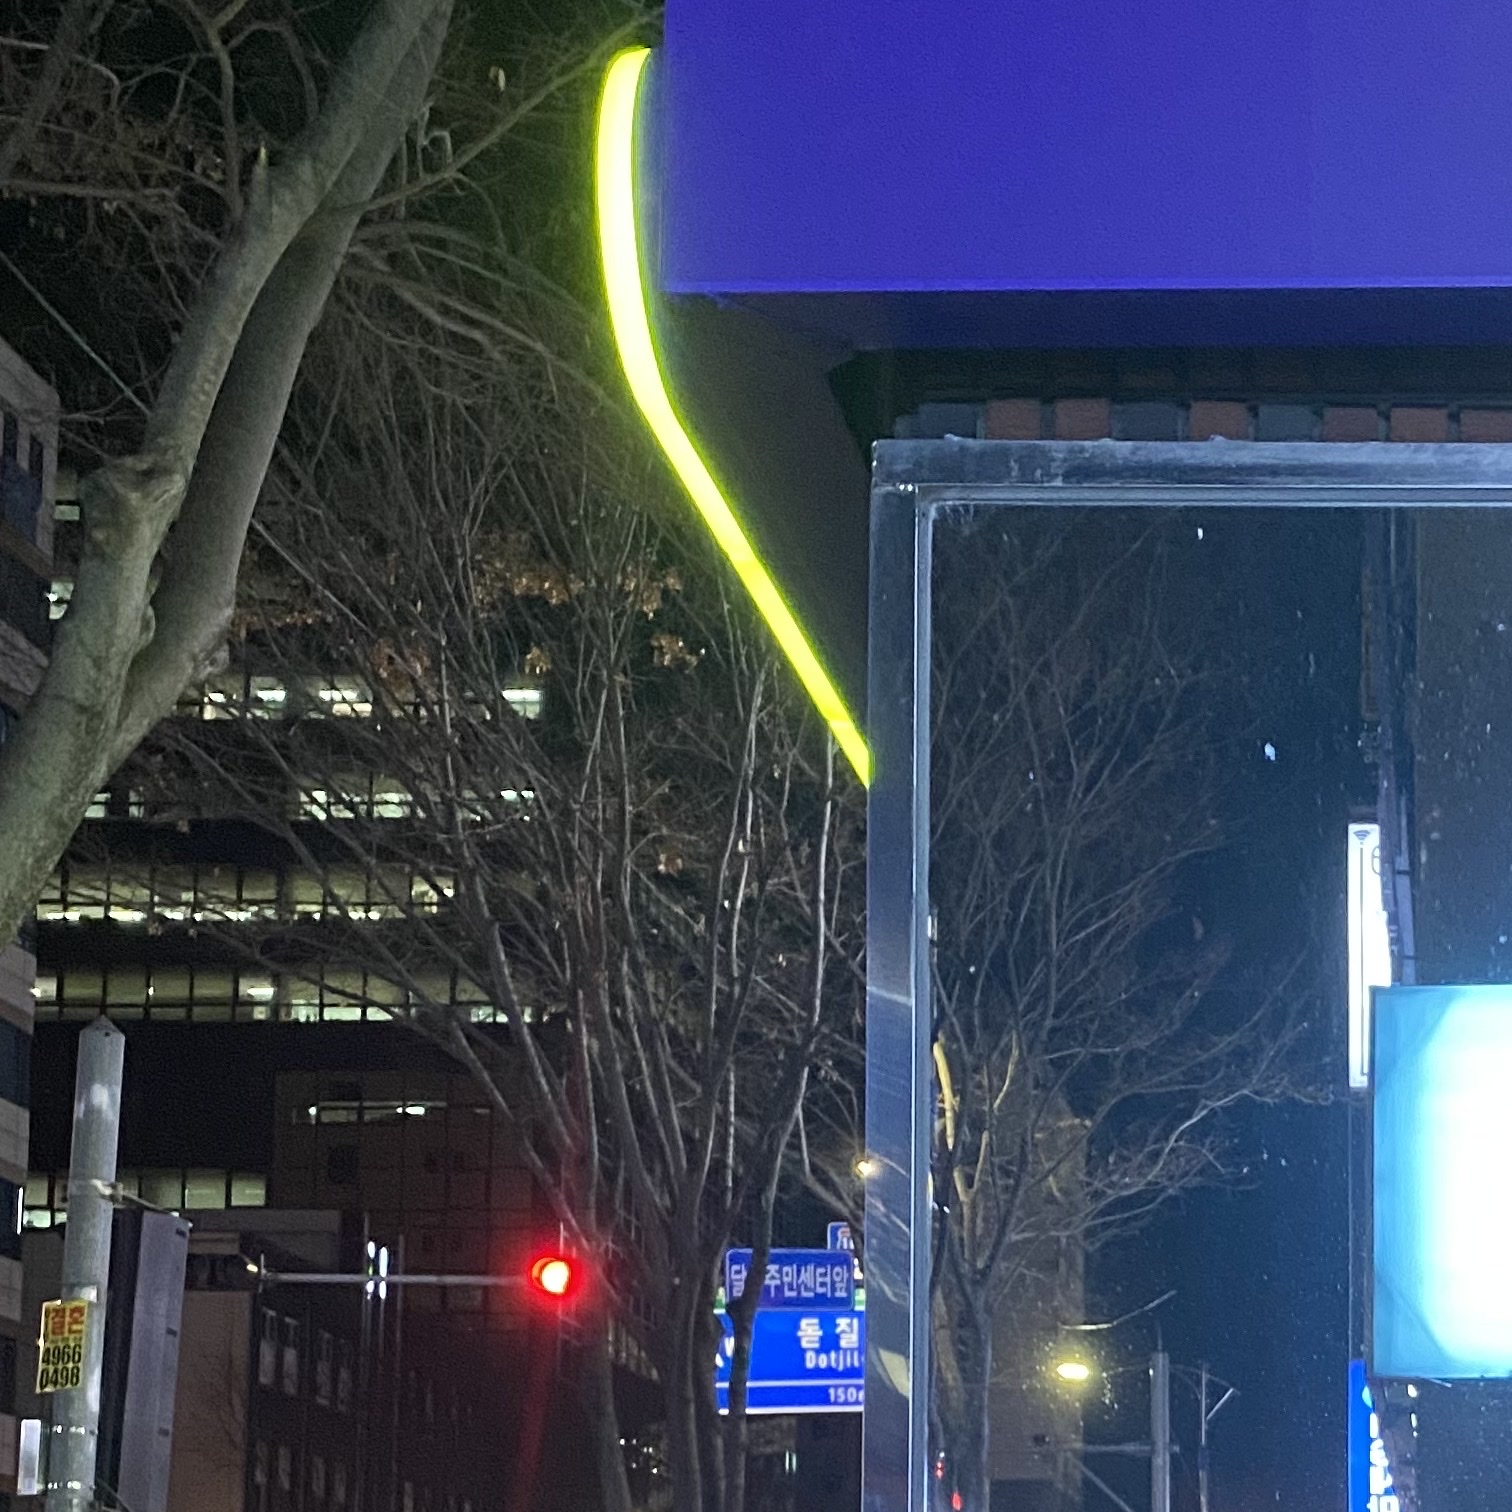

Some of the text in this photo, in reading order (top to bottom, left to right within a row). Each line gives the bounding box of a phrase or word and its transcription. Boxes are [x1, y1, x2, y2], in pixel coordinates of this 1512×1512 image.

[731, 1264, 848, 1297] 달주민센터앞
[797, 1318, 858, 1348] 돋질
[42, 1344, 81, 1366] 4966
[40, 1366, 80, 1390] 0498
